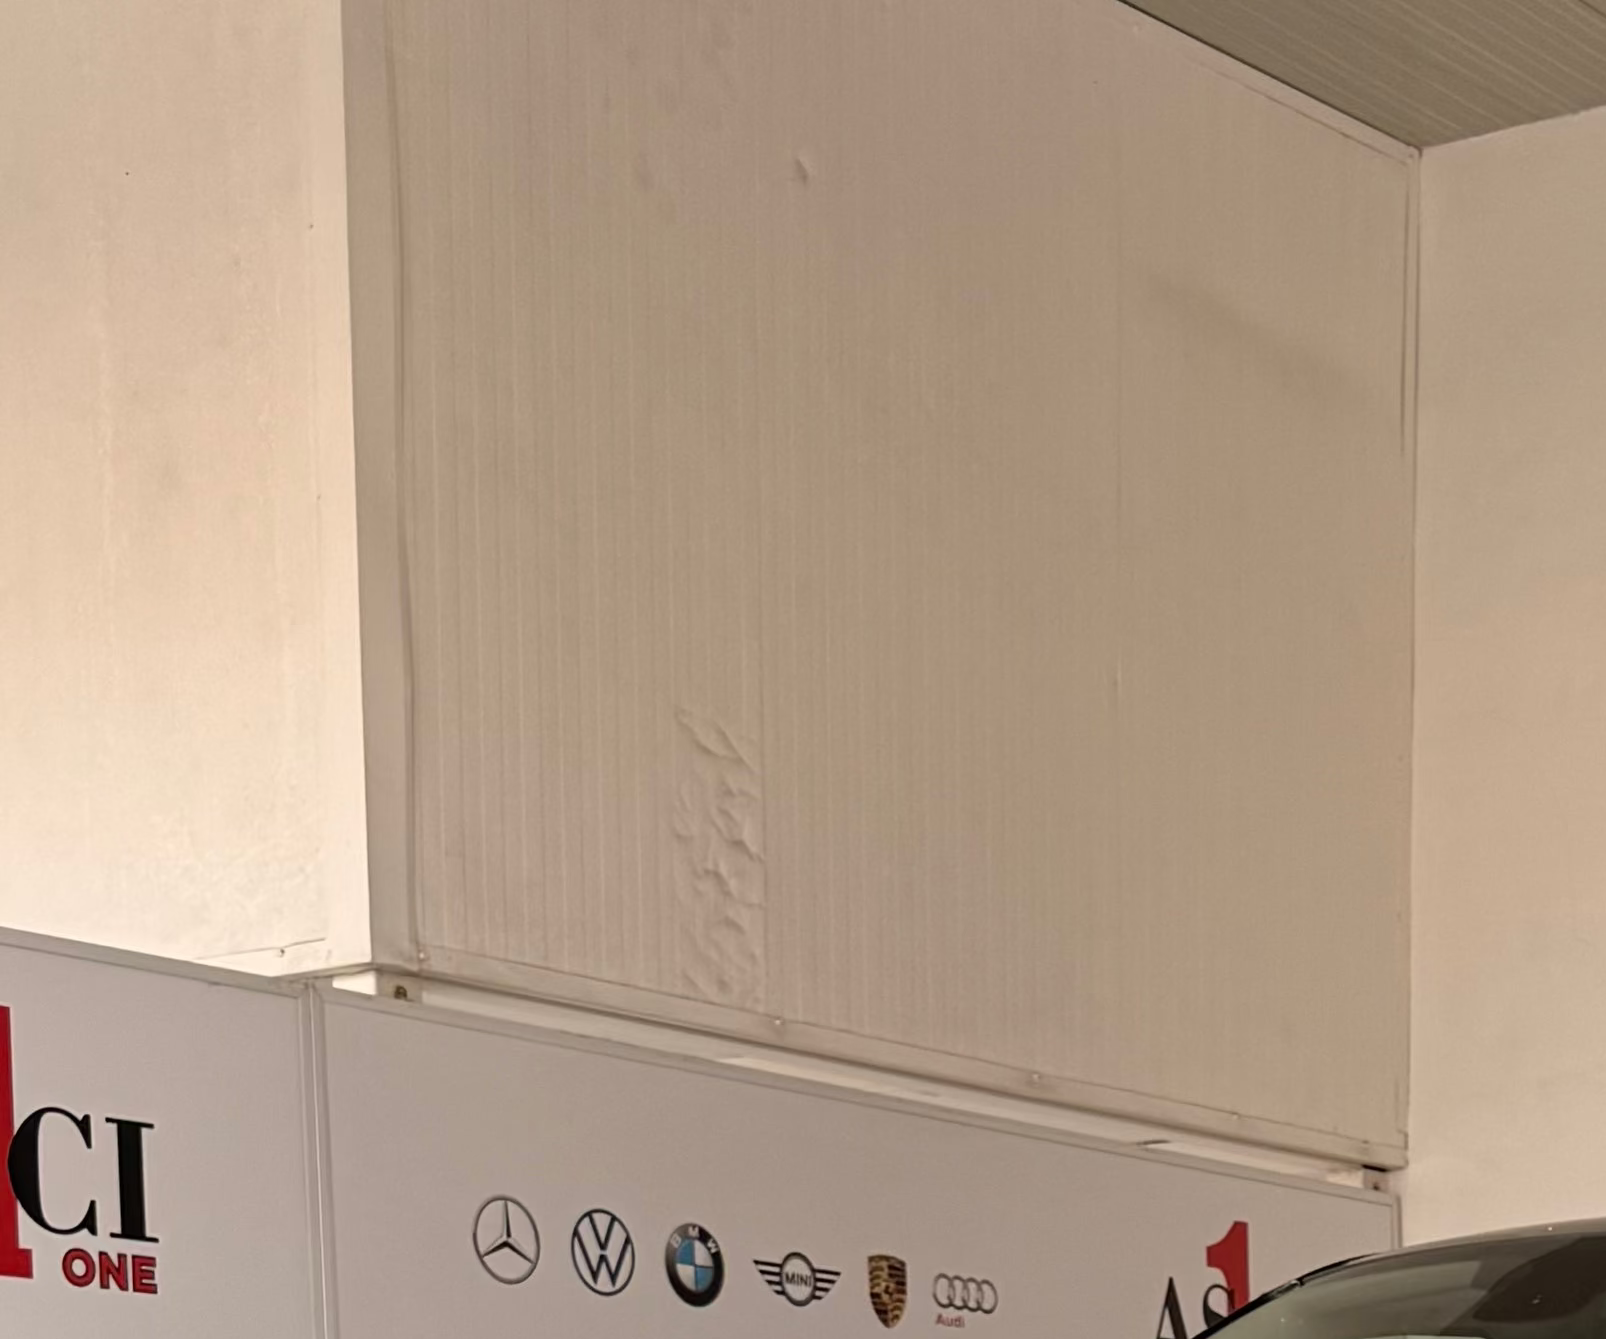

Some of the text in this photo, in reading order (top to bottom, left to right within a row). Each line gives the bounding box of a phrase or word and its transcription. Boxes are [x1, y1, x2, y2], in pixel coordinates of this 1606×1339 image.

[62, 1246, 158, 1295] ONE
[784, 1271, 813, 1289] MINI
[935, 1313, 966, 1329] Audi
